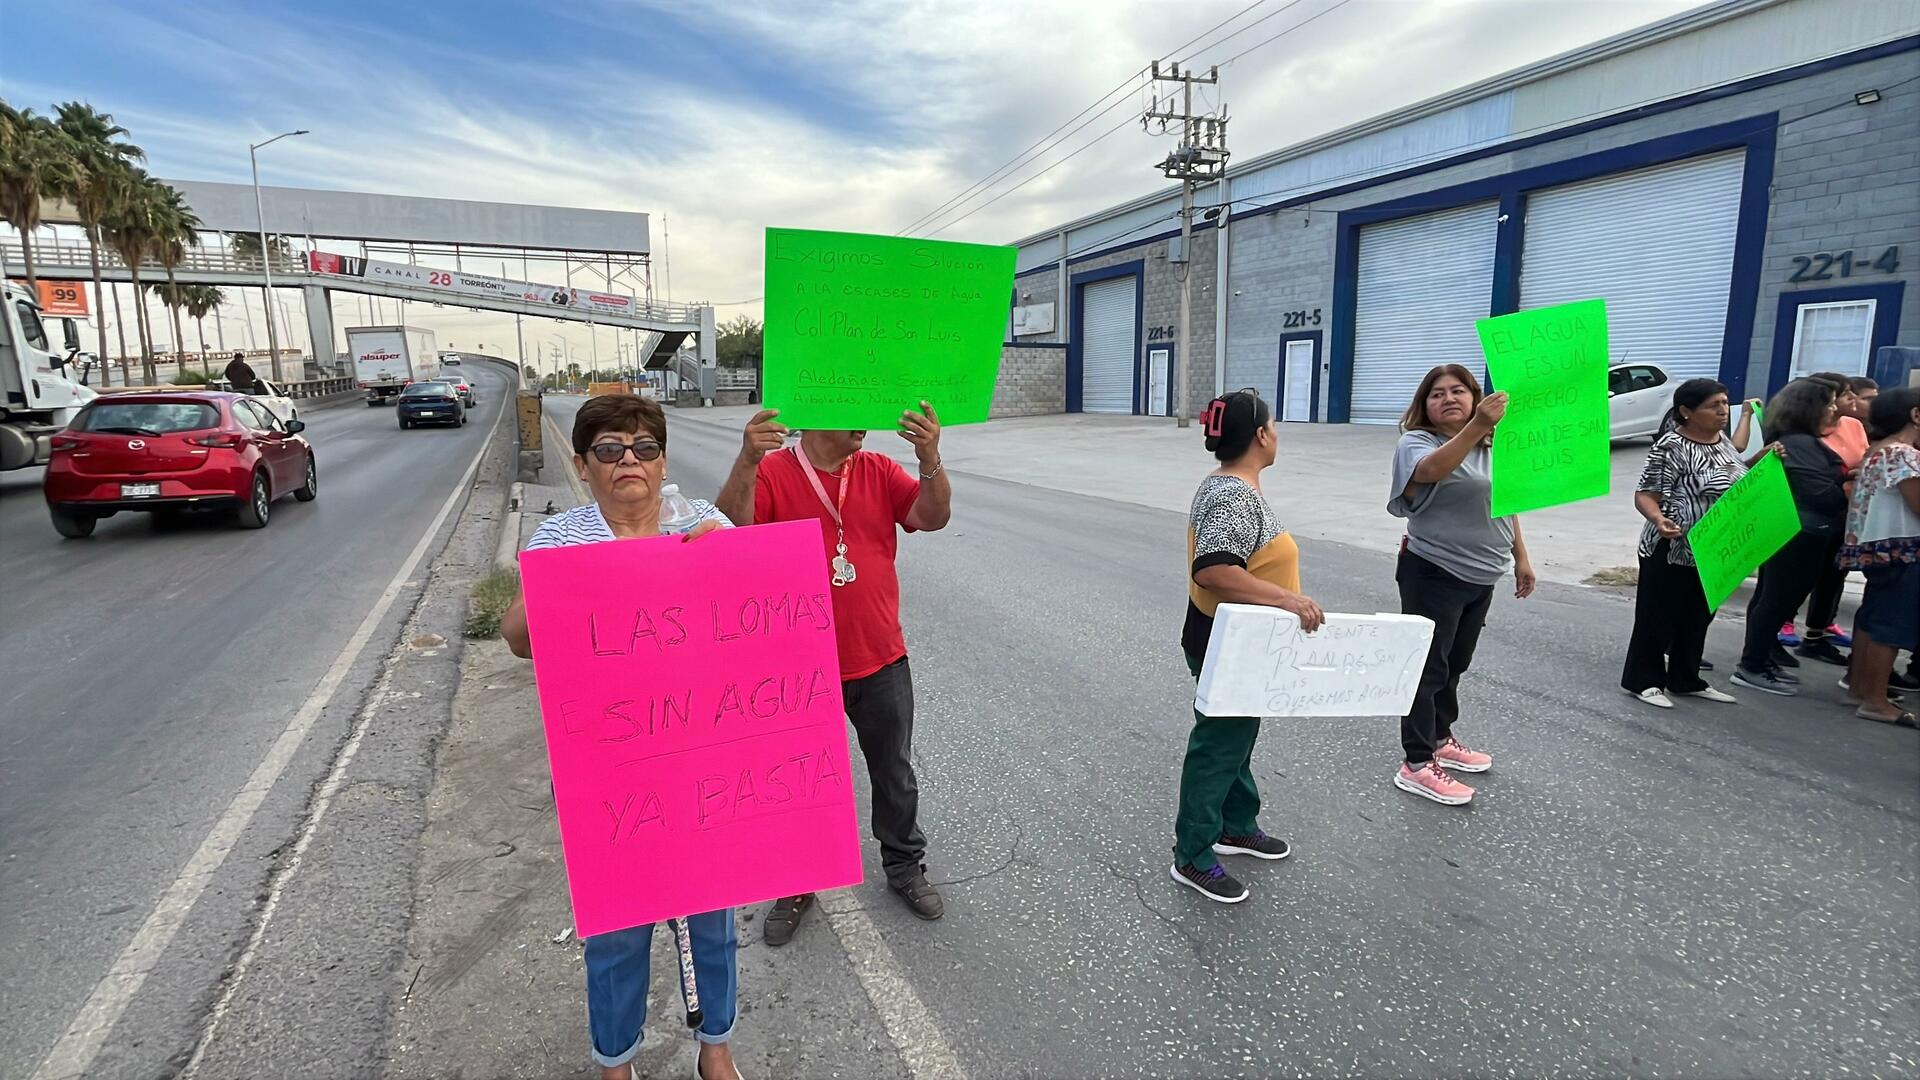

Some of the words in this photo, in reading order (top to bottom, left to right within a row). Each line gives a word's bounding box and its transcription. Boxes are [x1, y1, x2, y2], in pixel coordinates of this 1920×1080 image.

[344, 257, 360, 275] TV
[775, 232, 884, 273] Exigimos
[1788, 246, 1899, 282] 221-4
[374, 267, 420, 279] CANAL
[428, 271, 452, 286] 28
[796, 283, 805, 294] A
[813, 283, 831, 295] LA
[921, 287, 940, 299] DE
[951, 286, 983, 304] Agua
[794, 307, 823, 338] Col
[831, 310, 863, 338] Plan
[870, 315, 888, 340] de
[896, 322, 918, 341] San
[1148, 325, 1174, 341] 221-6
[1283, 309, 1321, 328] 221-5
[1491, 331, 1525, 354] EL
[1530, 316, 1589, 347] AGUA
[360, 353, 401, 361] alsuper
[867, 349, 875, 363] y
[1525, 355, 1553, 379] ES
[1561, 344, 1586, 370] UN
[1507, 386, 1578, 415] ERECHO
[1503, 430, 1547, 453] PLAN
[1553, 423, 1574, 443] DE
[1580, 418, 1606, 437] SAN
[1532, 448, 1574, 473] LUIS
[588, 606, 688, 656] LAS
[711, 593, 831, 642] LOMAS
[1270, 647, 1337, 679] PLAN
[1342, 655, 1367, 670] DE
[714, 666, 836, 728] AGUA
[602, 790, 666, 847] YA
[695, 745, 842, 825] BASTA
